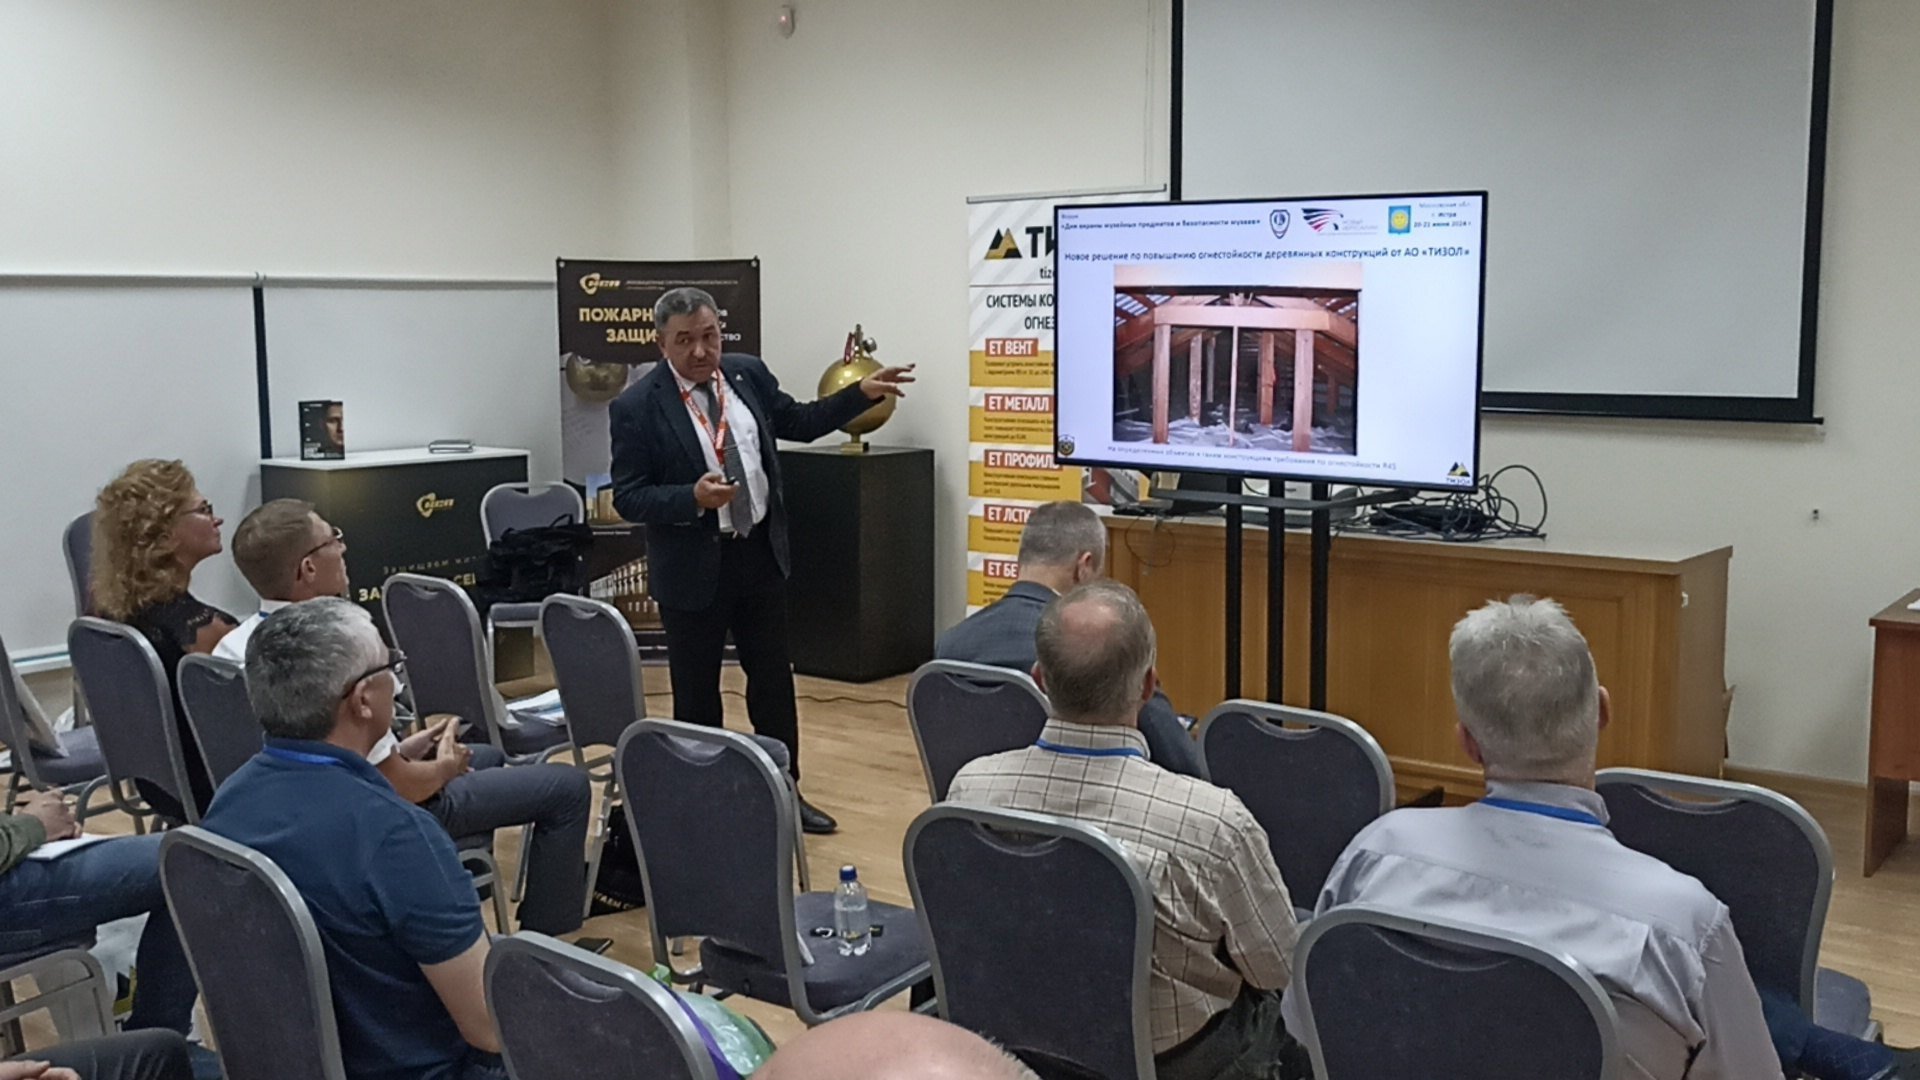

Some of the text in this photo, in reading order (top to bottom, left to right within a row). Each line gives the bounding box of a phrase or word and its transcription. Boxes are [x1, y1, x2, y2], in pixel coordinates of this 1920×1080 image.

[1064, 246, 1470, 263] Новое решение по повышению огнестойкости деревянных конструкций от АО «ТИЗОЛ»
[986, 294, 1037, 308] СИСТЕМЫ
[606, 328, 659, 345] ЗАЩИ
[1004, 340, 1034, 356] ВЕНТ
[1004, 396, 1050, 412] МЕТАЛЛ
